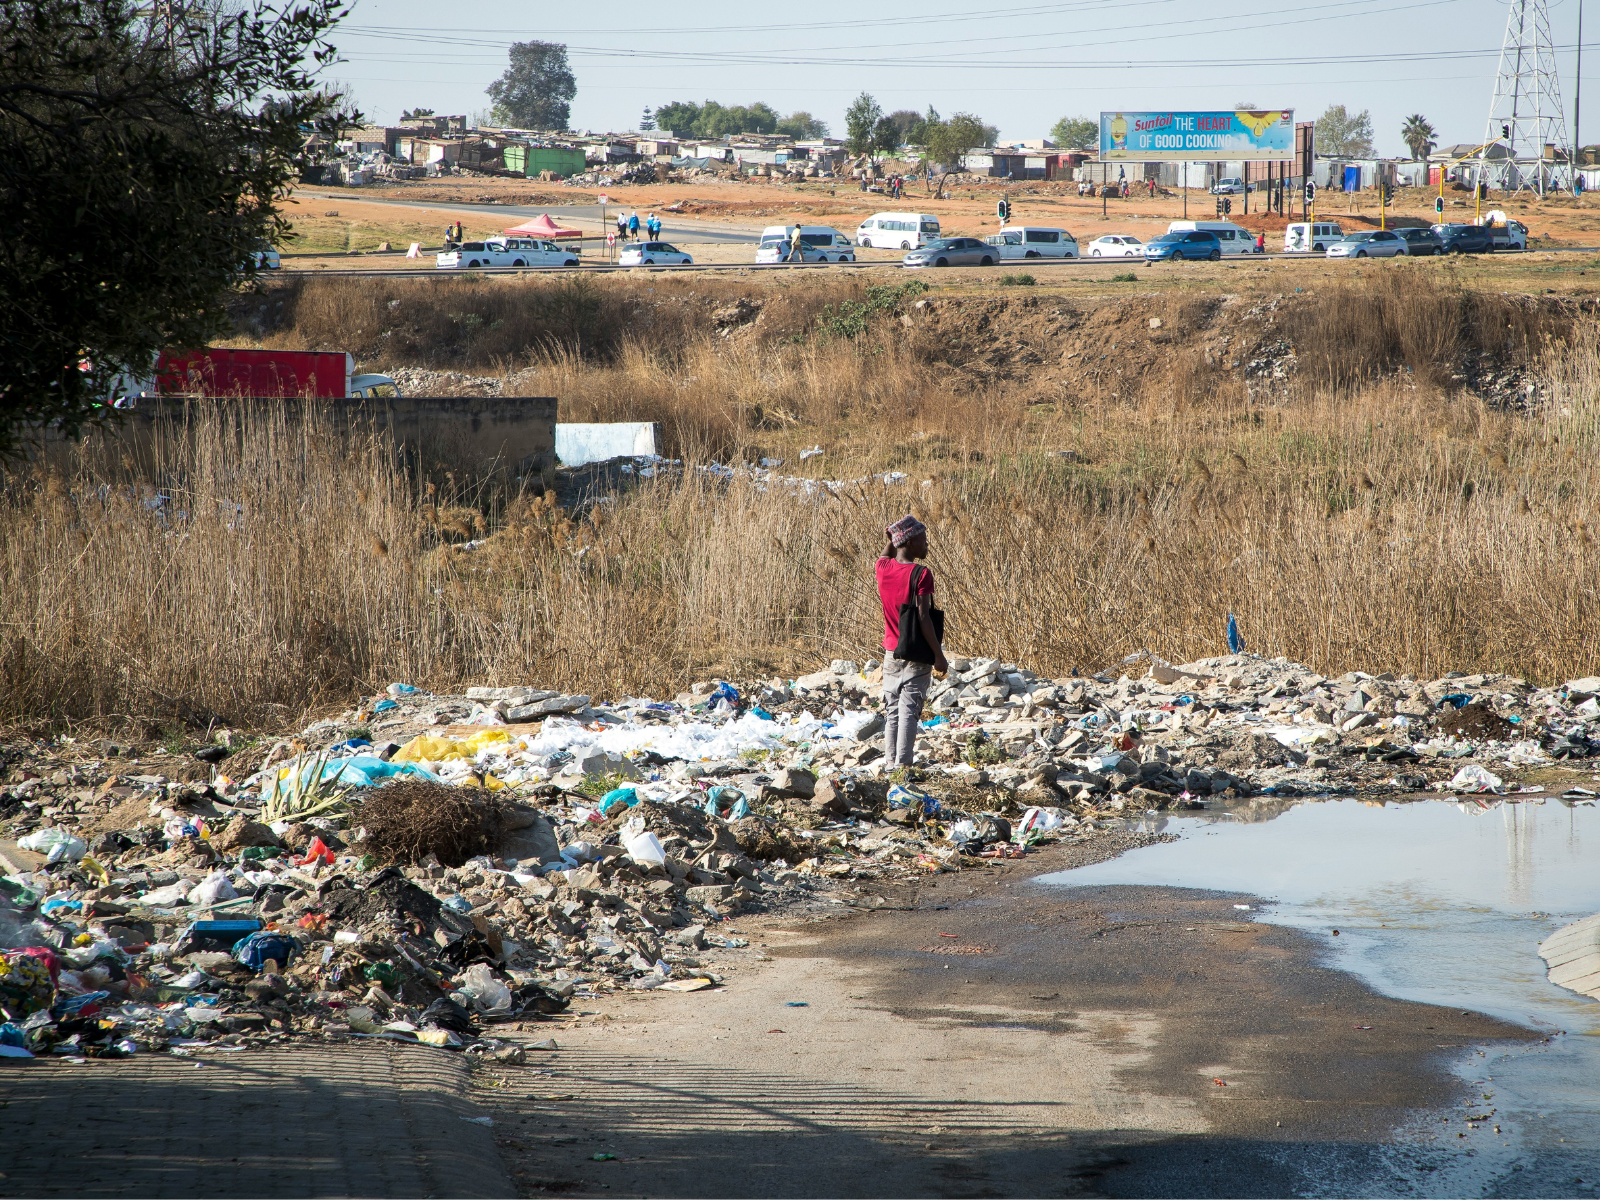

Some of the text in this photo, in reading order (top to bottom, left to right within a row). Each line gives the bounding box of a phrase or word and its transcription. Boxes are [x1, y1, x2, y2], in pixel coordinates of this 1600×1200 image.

[1135, 113, 1173, 131] Sunfoil
[1175, 117, 1194, 131] THE
[1197, 117, 1232, 131] HEART
[1139, 134, 1232, 148] OF GOOD COOKING
